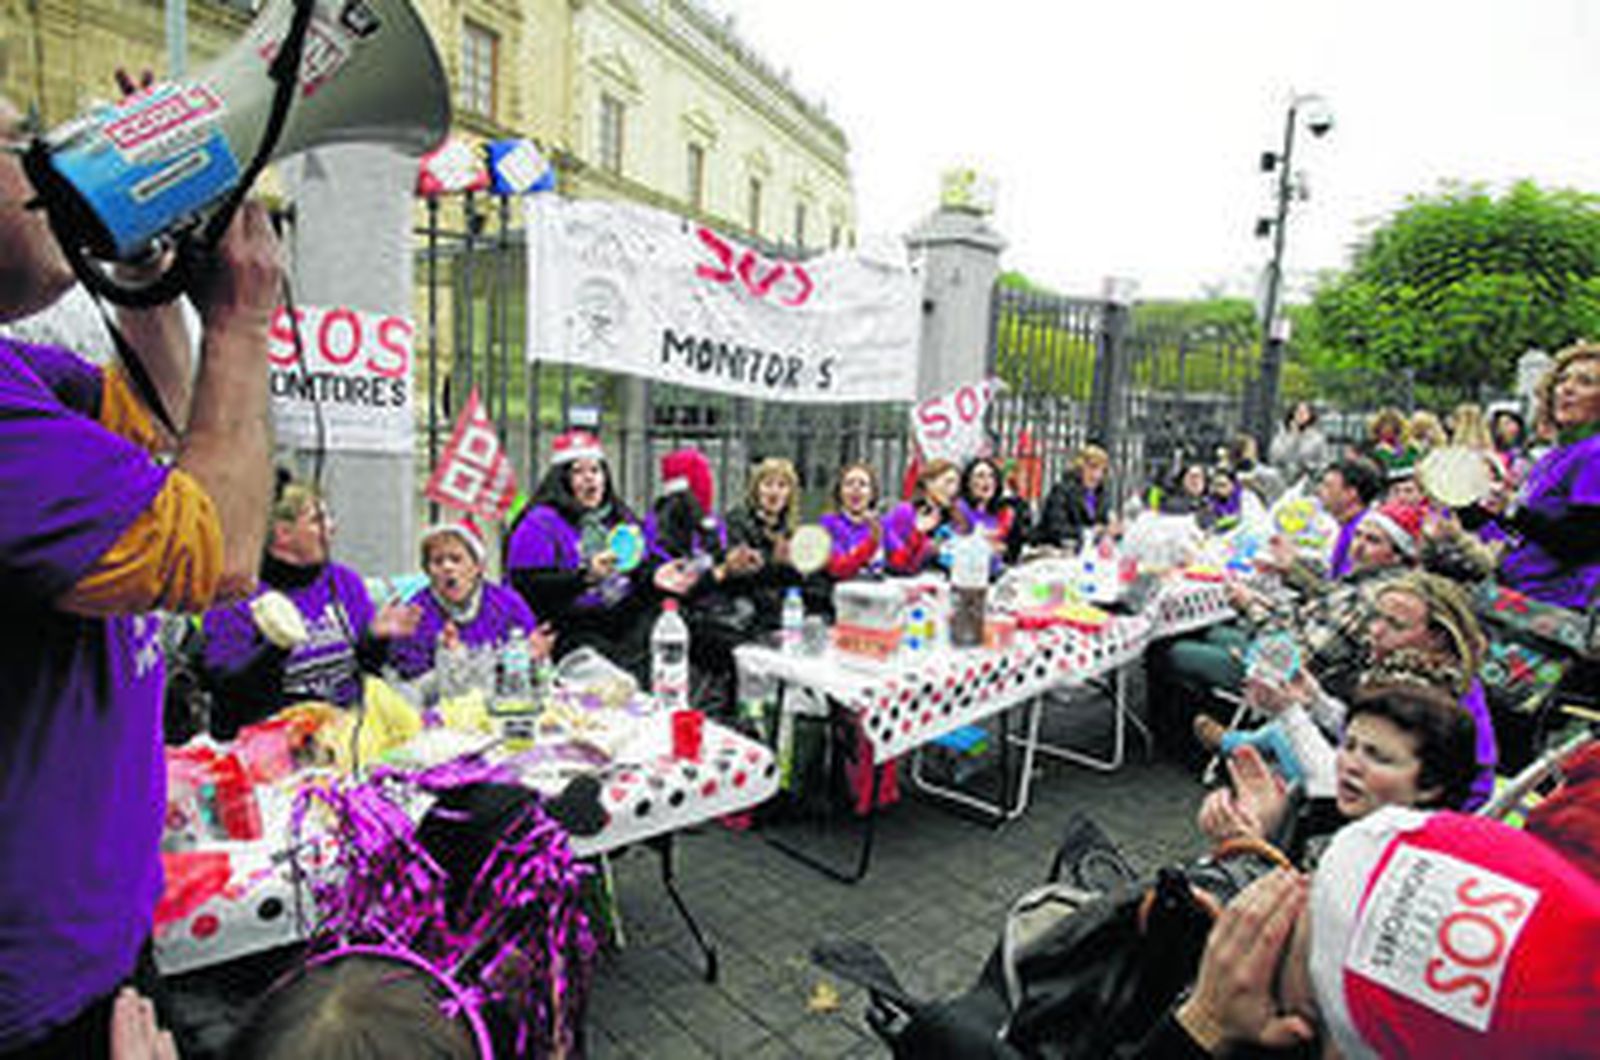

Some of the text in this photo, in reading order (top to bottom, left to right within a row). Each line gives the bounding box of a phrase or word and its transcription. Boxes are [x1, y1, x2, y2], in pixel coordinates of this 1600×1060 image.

[267, 304, 413, 379] SOS
[661, 327, 834, 389] MONITORS
[269, 370, 407, 407] ONITORES
[917, 386, 990, 440] SO
[1424, 876, 1527, 1009] SOS
